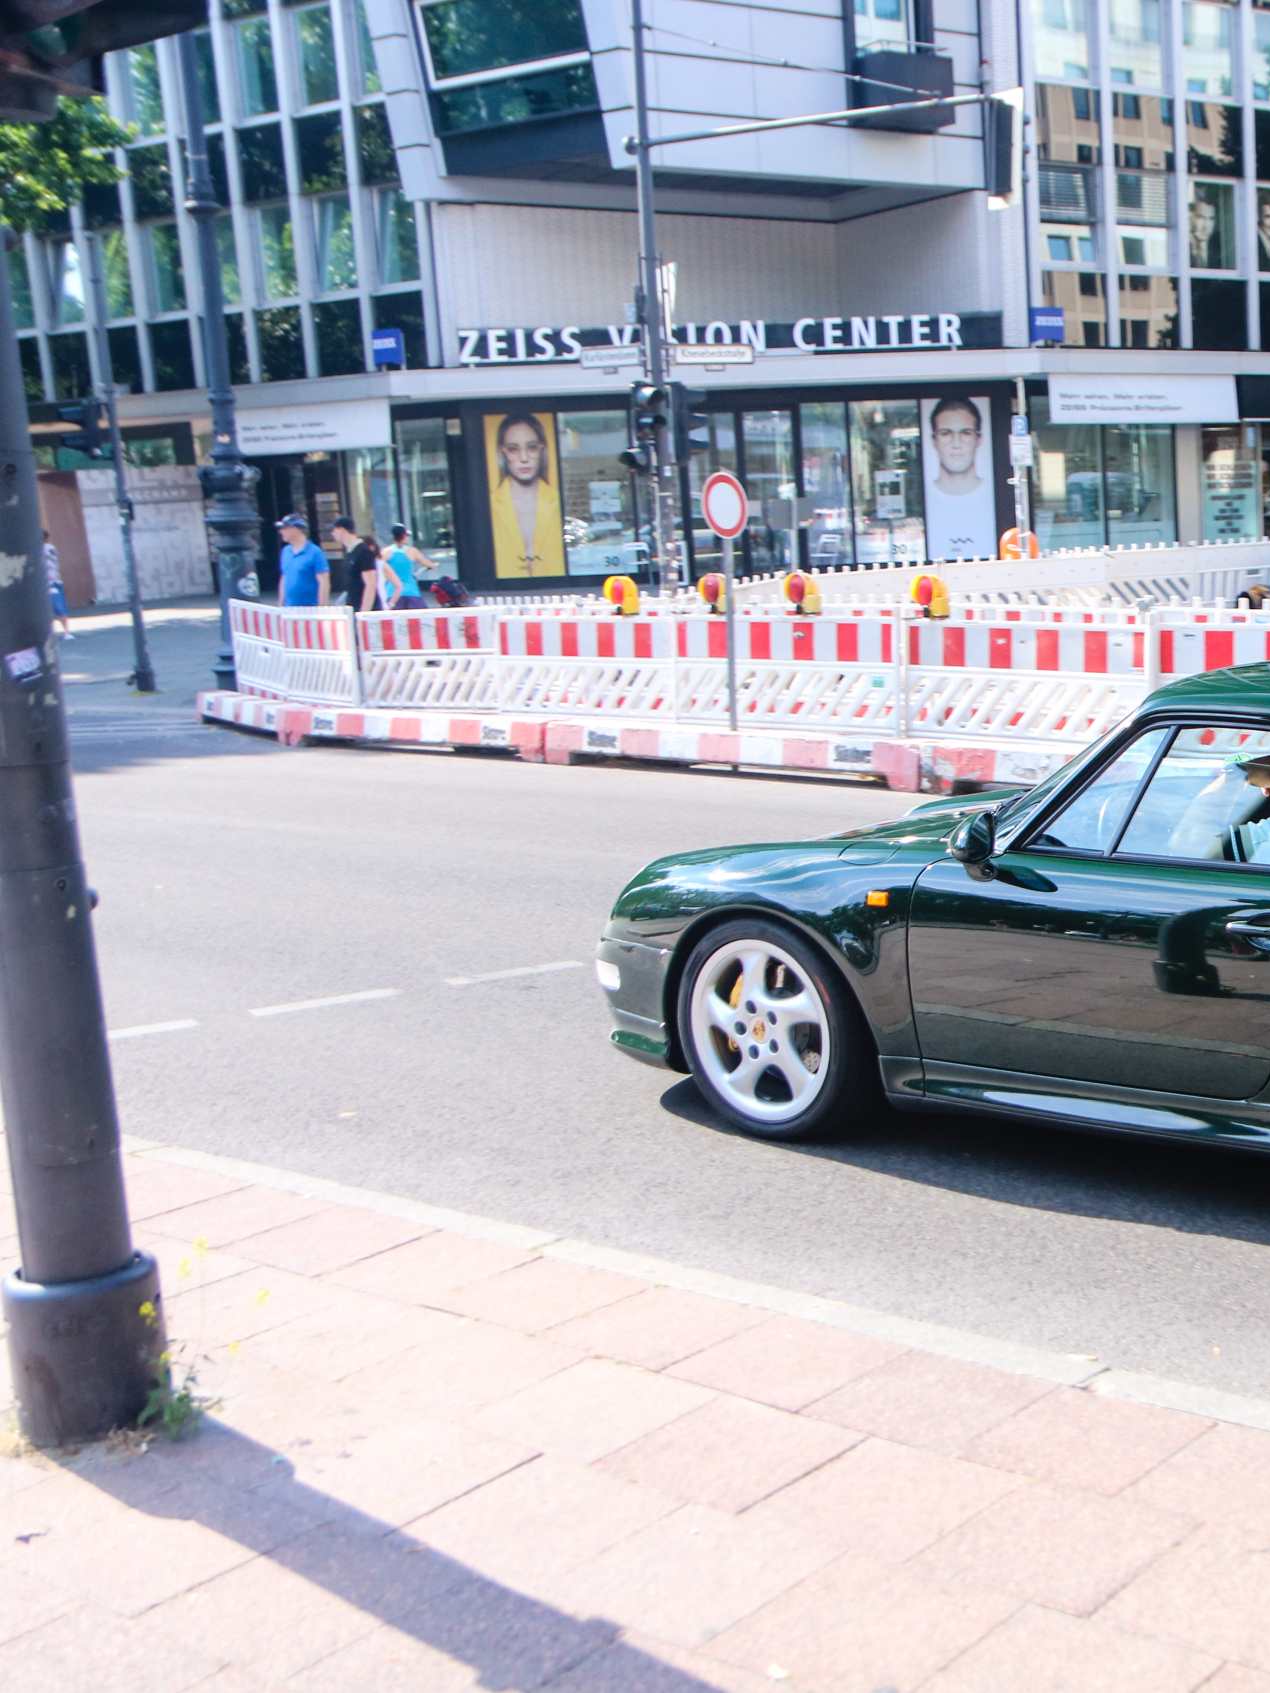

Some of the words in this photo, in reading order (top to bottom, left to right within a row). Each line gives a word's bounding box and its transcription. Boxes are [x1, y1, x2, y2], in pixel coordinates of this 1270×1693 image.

[457, 325, 583, 364] ZEISS
[607, 319, 767, 351] VION
[792, 313, 963, 351] CENTER
[108, 487, 188, 502] LNGCHAMP
[604, 556, 620, 567] 30
